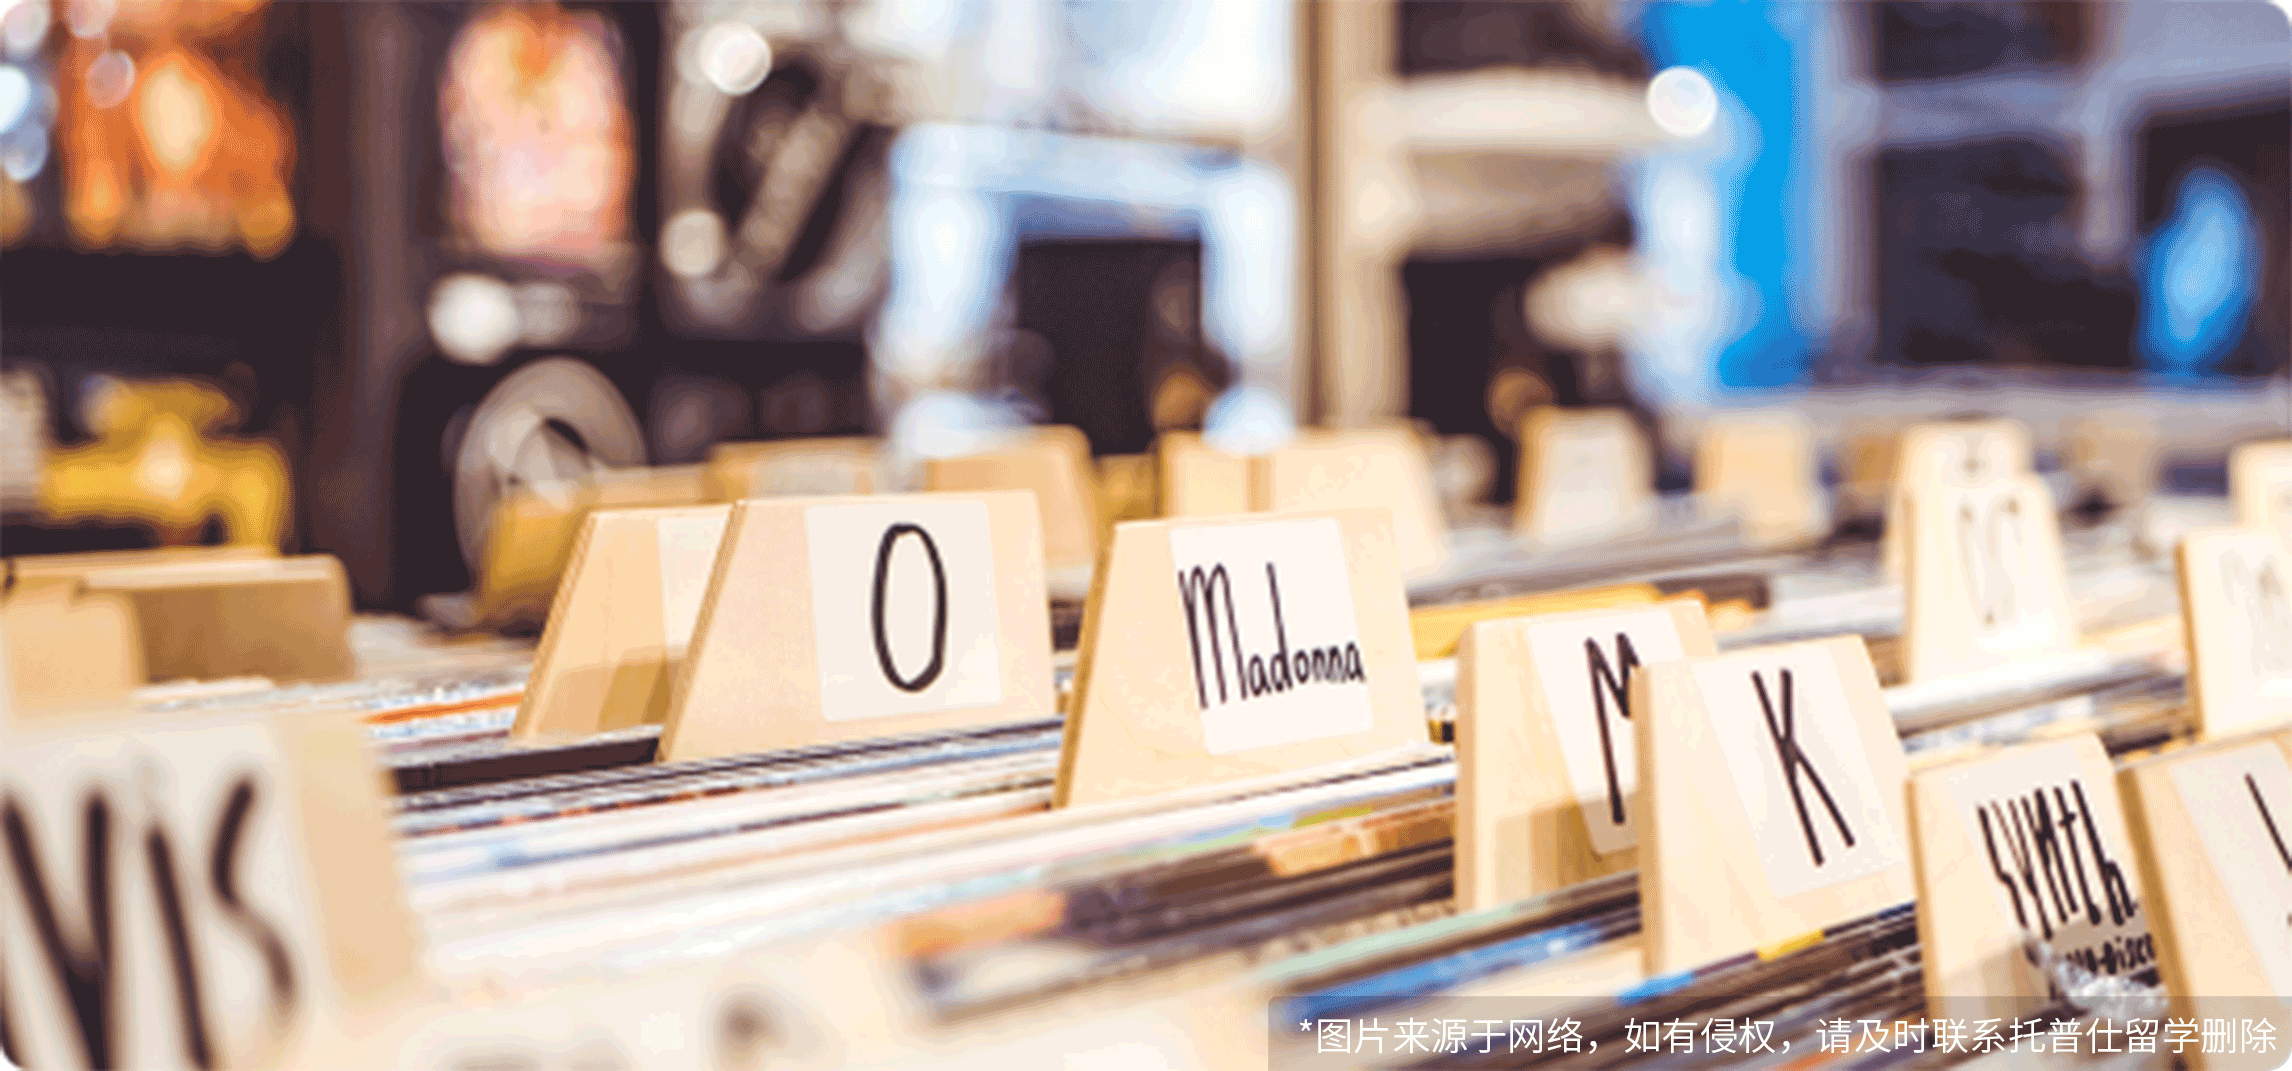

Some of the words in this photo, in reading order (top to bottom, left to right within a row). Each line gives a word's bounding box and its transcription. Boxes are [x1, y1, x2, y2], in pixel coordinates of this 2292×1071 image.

[871, 522, 949, 694] O
[1177, 562, 1366, 710] Madonna
[1751, 668, 1856, 868] K
